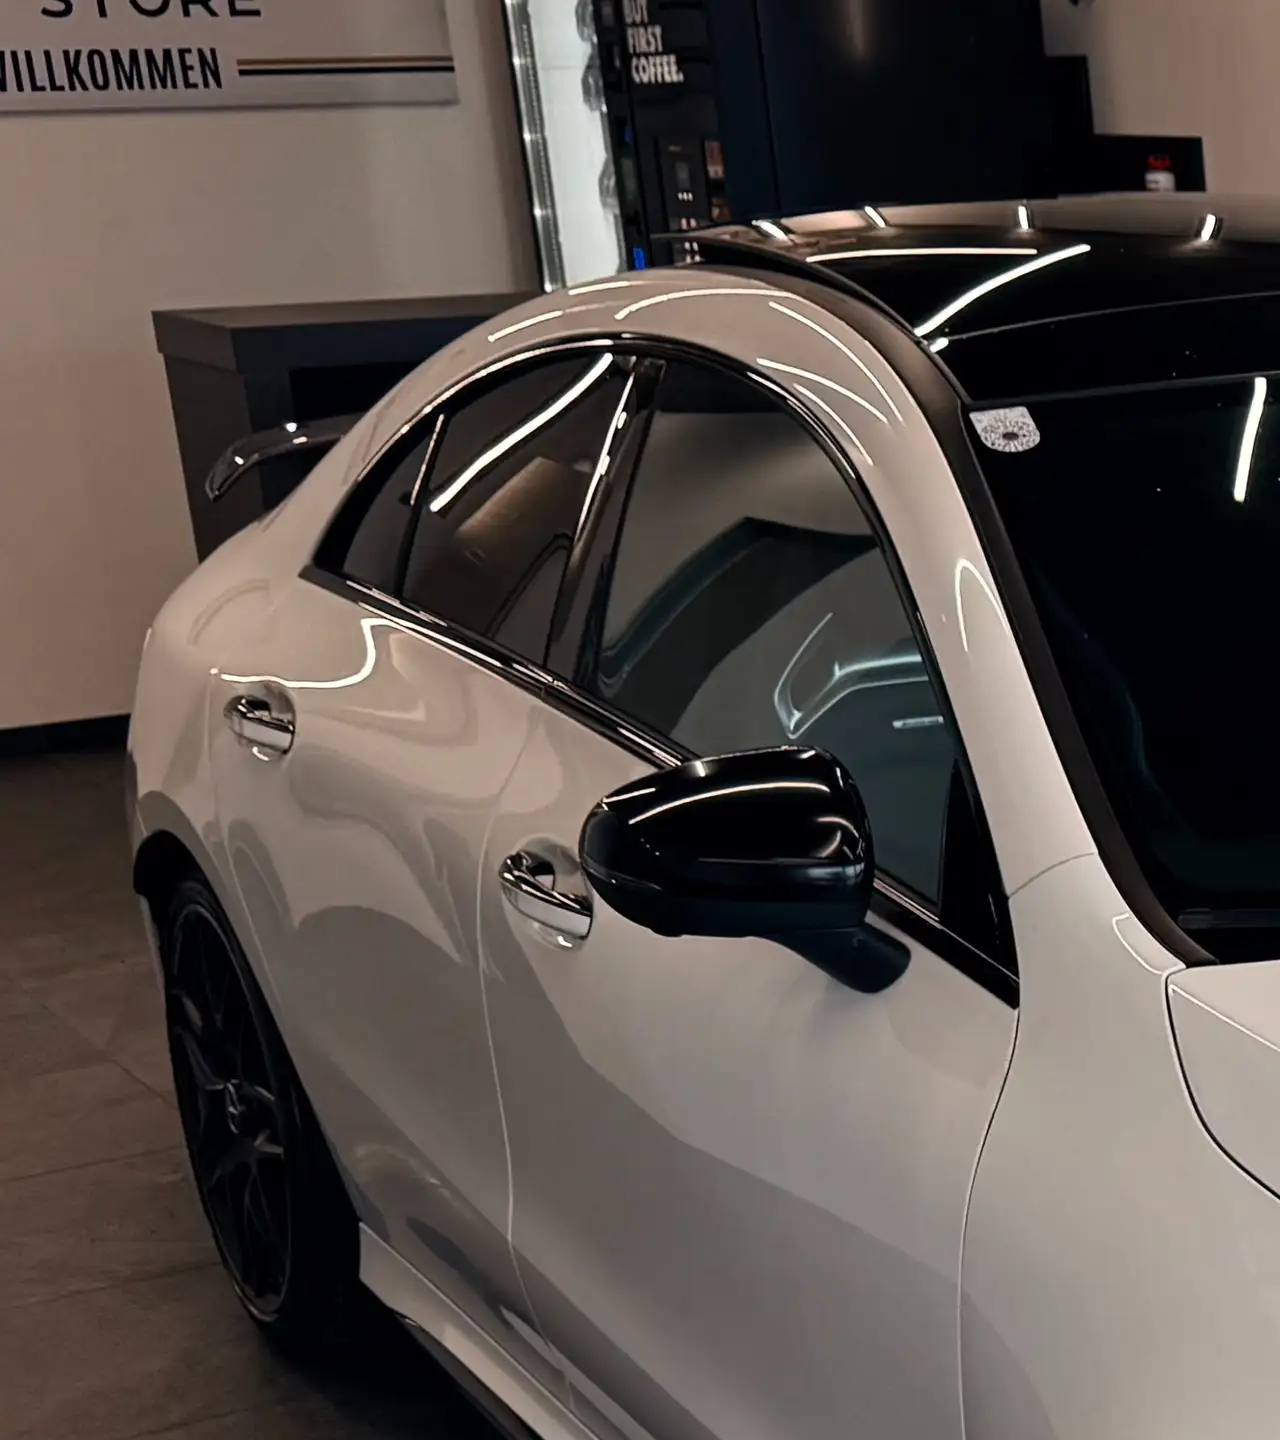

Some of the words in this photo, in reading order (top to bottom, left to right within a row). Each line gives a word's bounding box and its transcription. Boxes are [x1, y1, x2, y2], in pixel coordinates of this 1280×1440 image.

[627, 24, 663, 54] FIRST
[0, 48, 223, 92] ILLKOMMEN
[631, 53, 684, 84] COFFEE.
